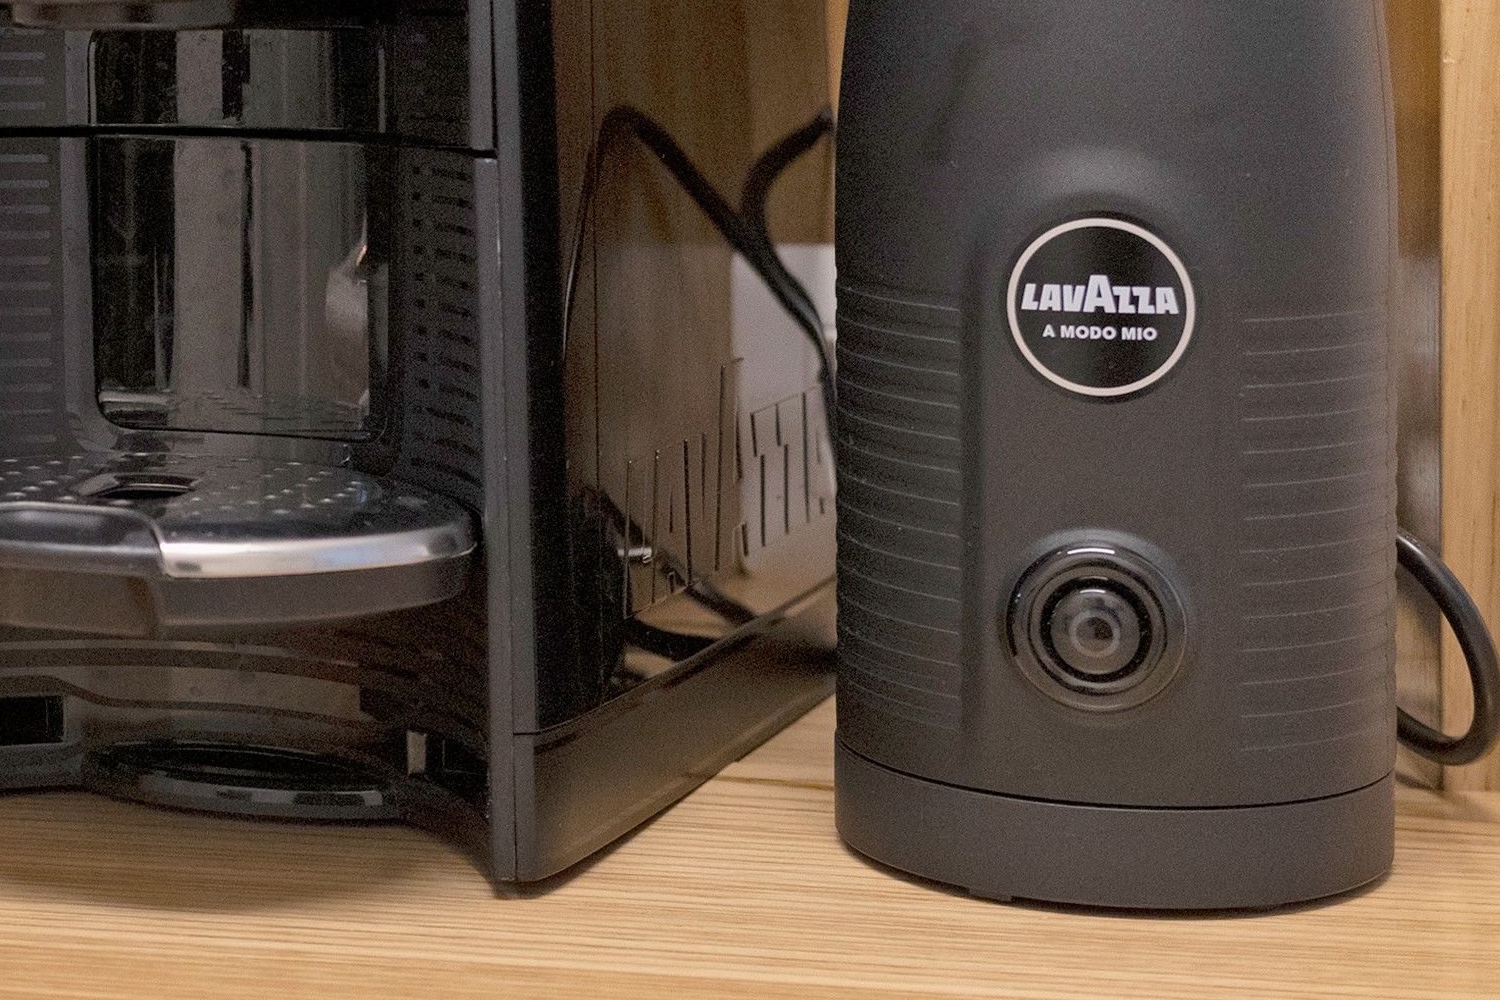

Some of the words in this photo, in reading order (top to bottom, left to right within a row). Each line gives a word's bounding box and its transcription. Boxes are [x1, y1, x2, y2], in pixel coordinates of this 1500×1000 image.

[1021, 274, 1179, 314] LAVAZZA
[1042, 324, 1056, 338] A
[1060, 325, 1117, 340] MODO
[1121, 327, 1158, 341] MIO
